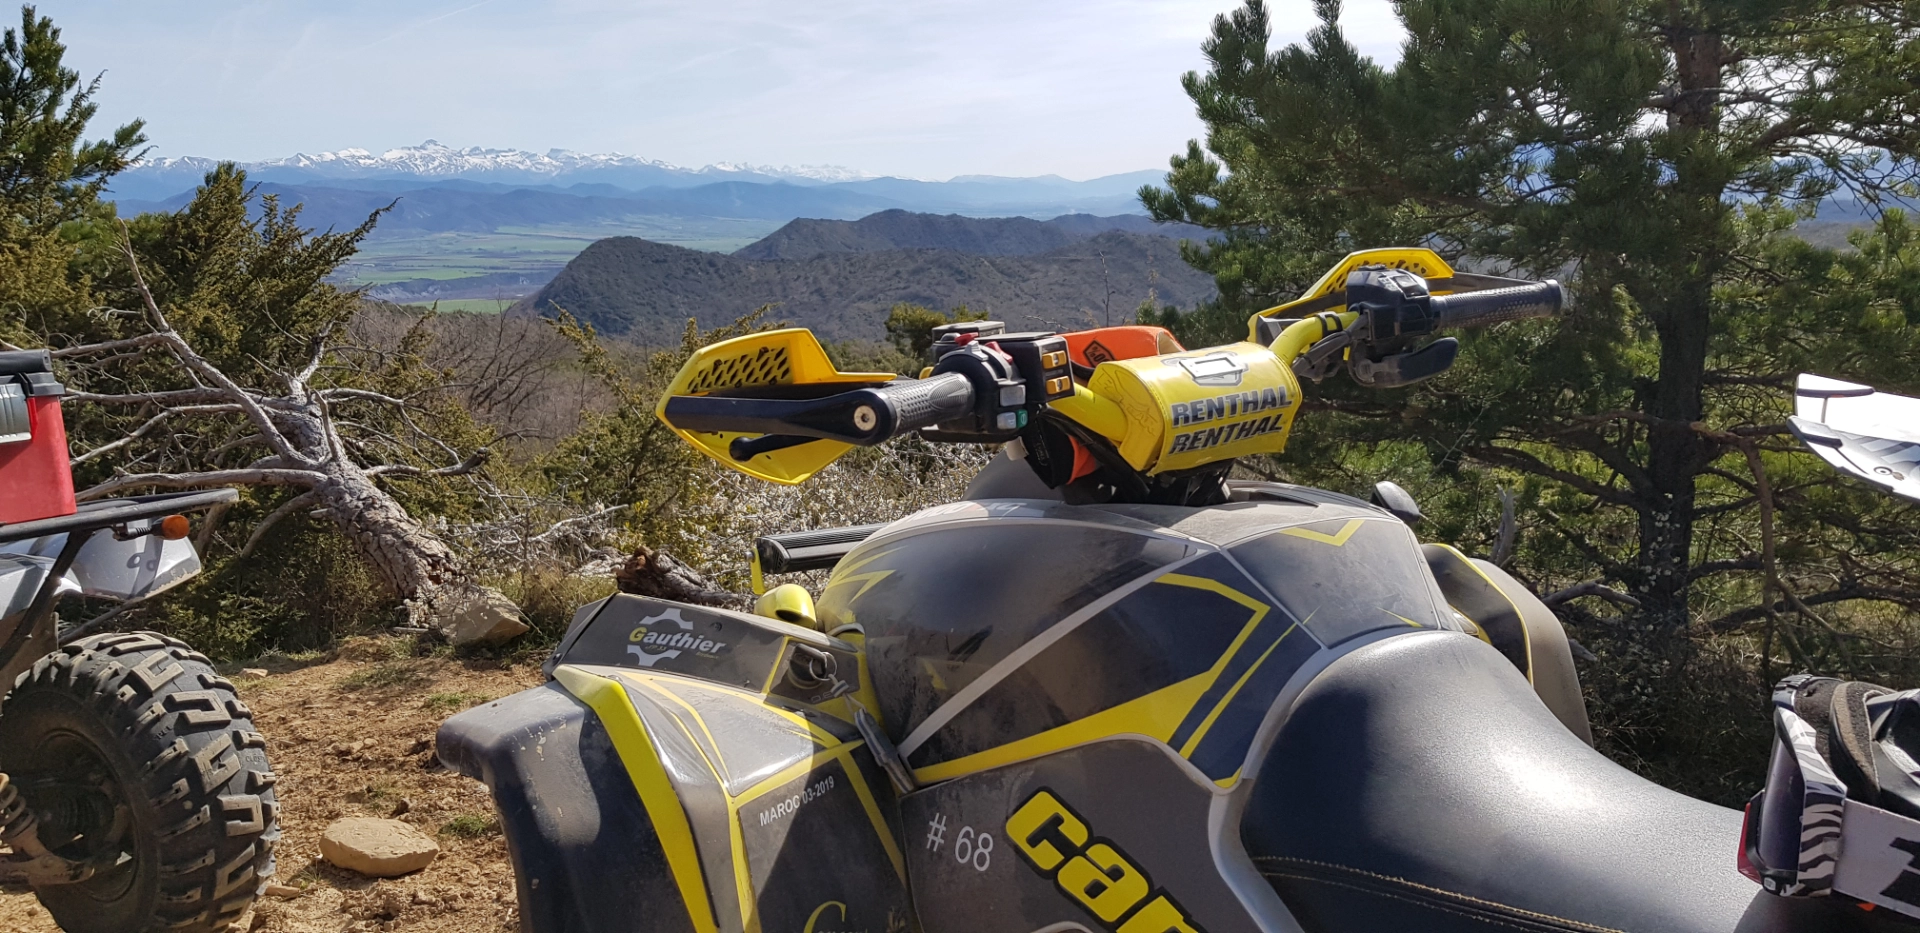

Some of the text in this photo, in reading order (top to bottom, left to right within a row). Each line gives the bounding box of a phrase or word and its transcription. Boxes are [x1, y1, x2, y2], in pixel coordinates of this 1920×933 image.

[1171, 386, 1292, 428] RENTHAL
[1168, 413, 1283, 456] RENTHAL
[629, 627, 726, 653] Gauthier
[760, 775, 834, 826] MAROC 03-2019
[955, 827, 993, 871] 68
